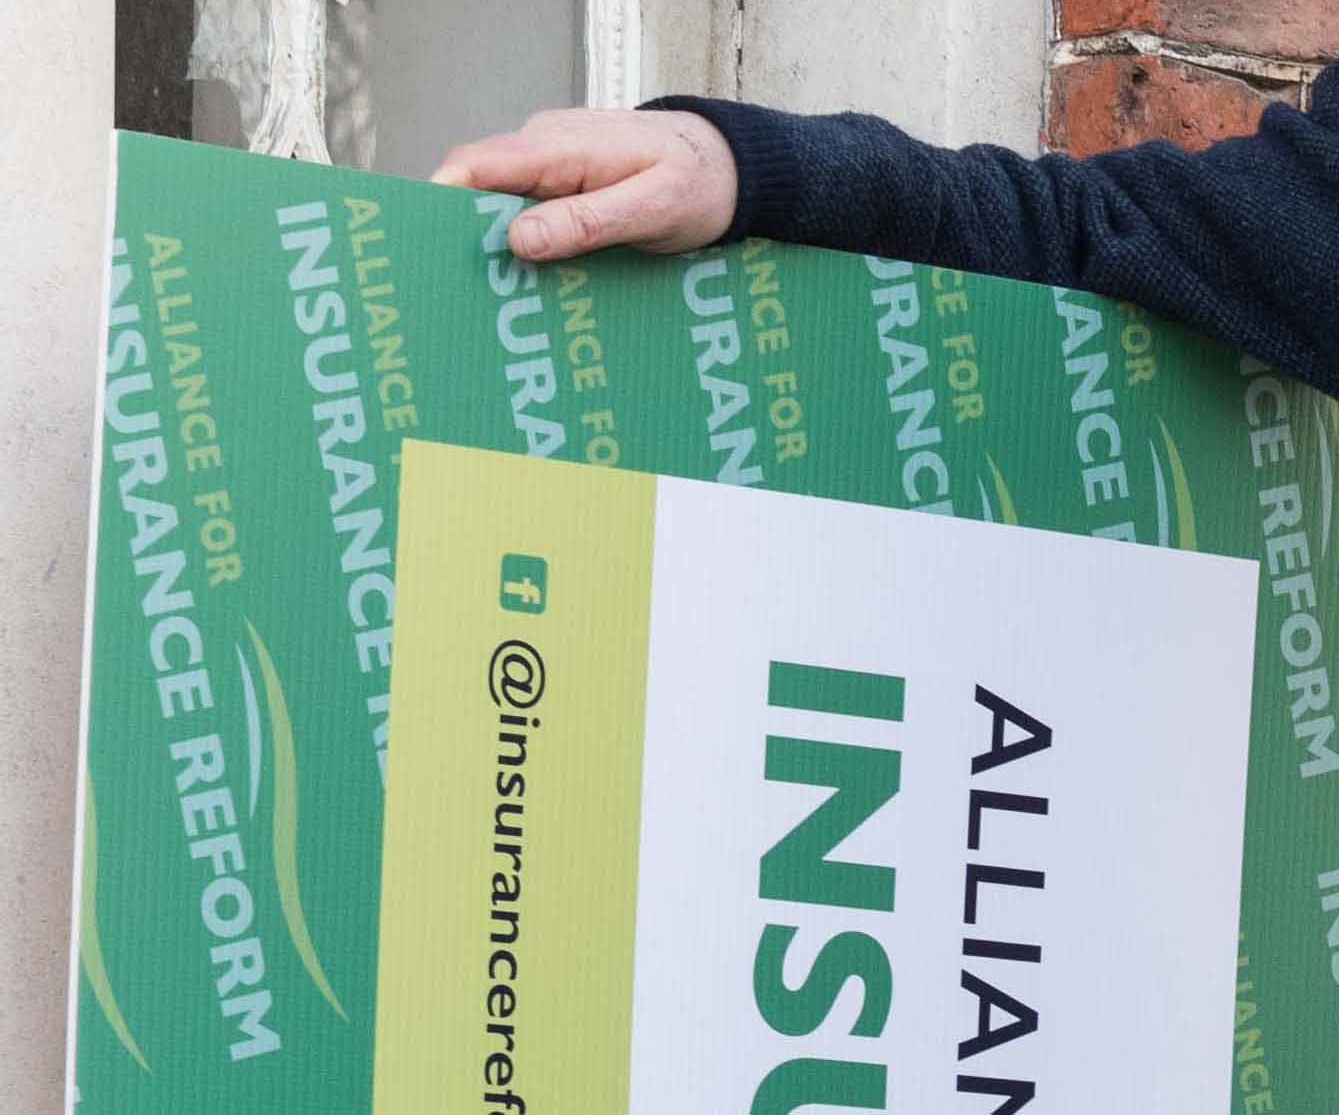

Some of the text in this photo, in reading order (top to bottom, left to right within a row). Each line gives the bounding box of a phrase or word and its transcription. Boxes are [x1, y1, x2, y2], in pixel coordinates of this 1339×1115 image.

[144, 232, 243, 588] ALLIANCE FOR
[275, 201, 396, 673] INSURANCE
[343, 195, 420, 433] ALLIANCE
[762, 371, 808, 464] FOR
[942, 333, 984, 424] FOR
[1053, 286, 1130, 506] ANCE
[170, 733, 282, 1062] REFORM
[484, 640, 546, 1115] @insuranceref
